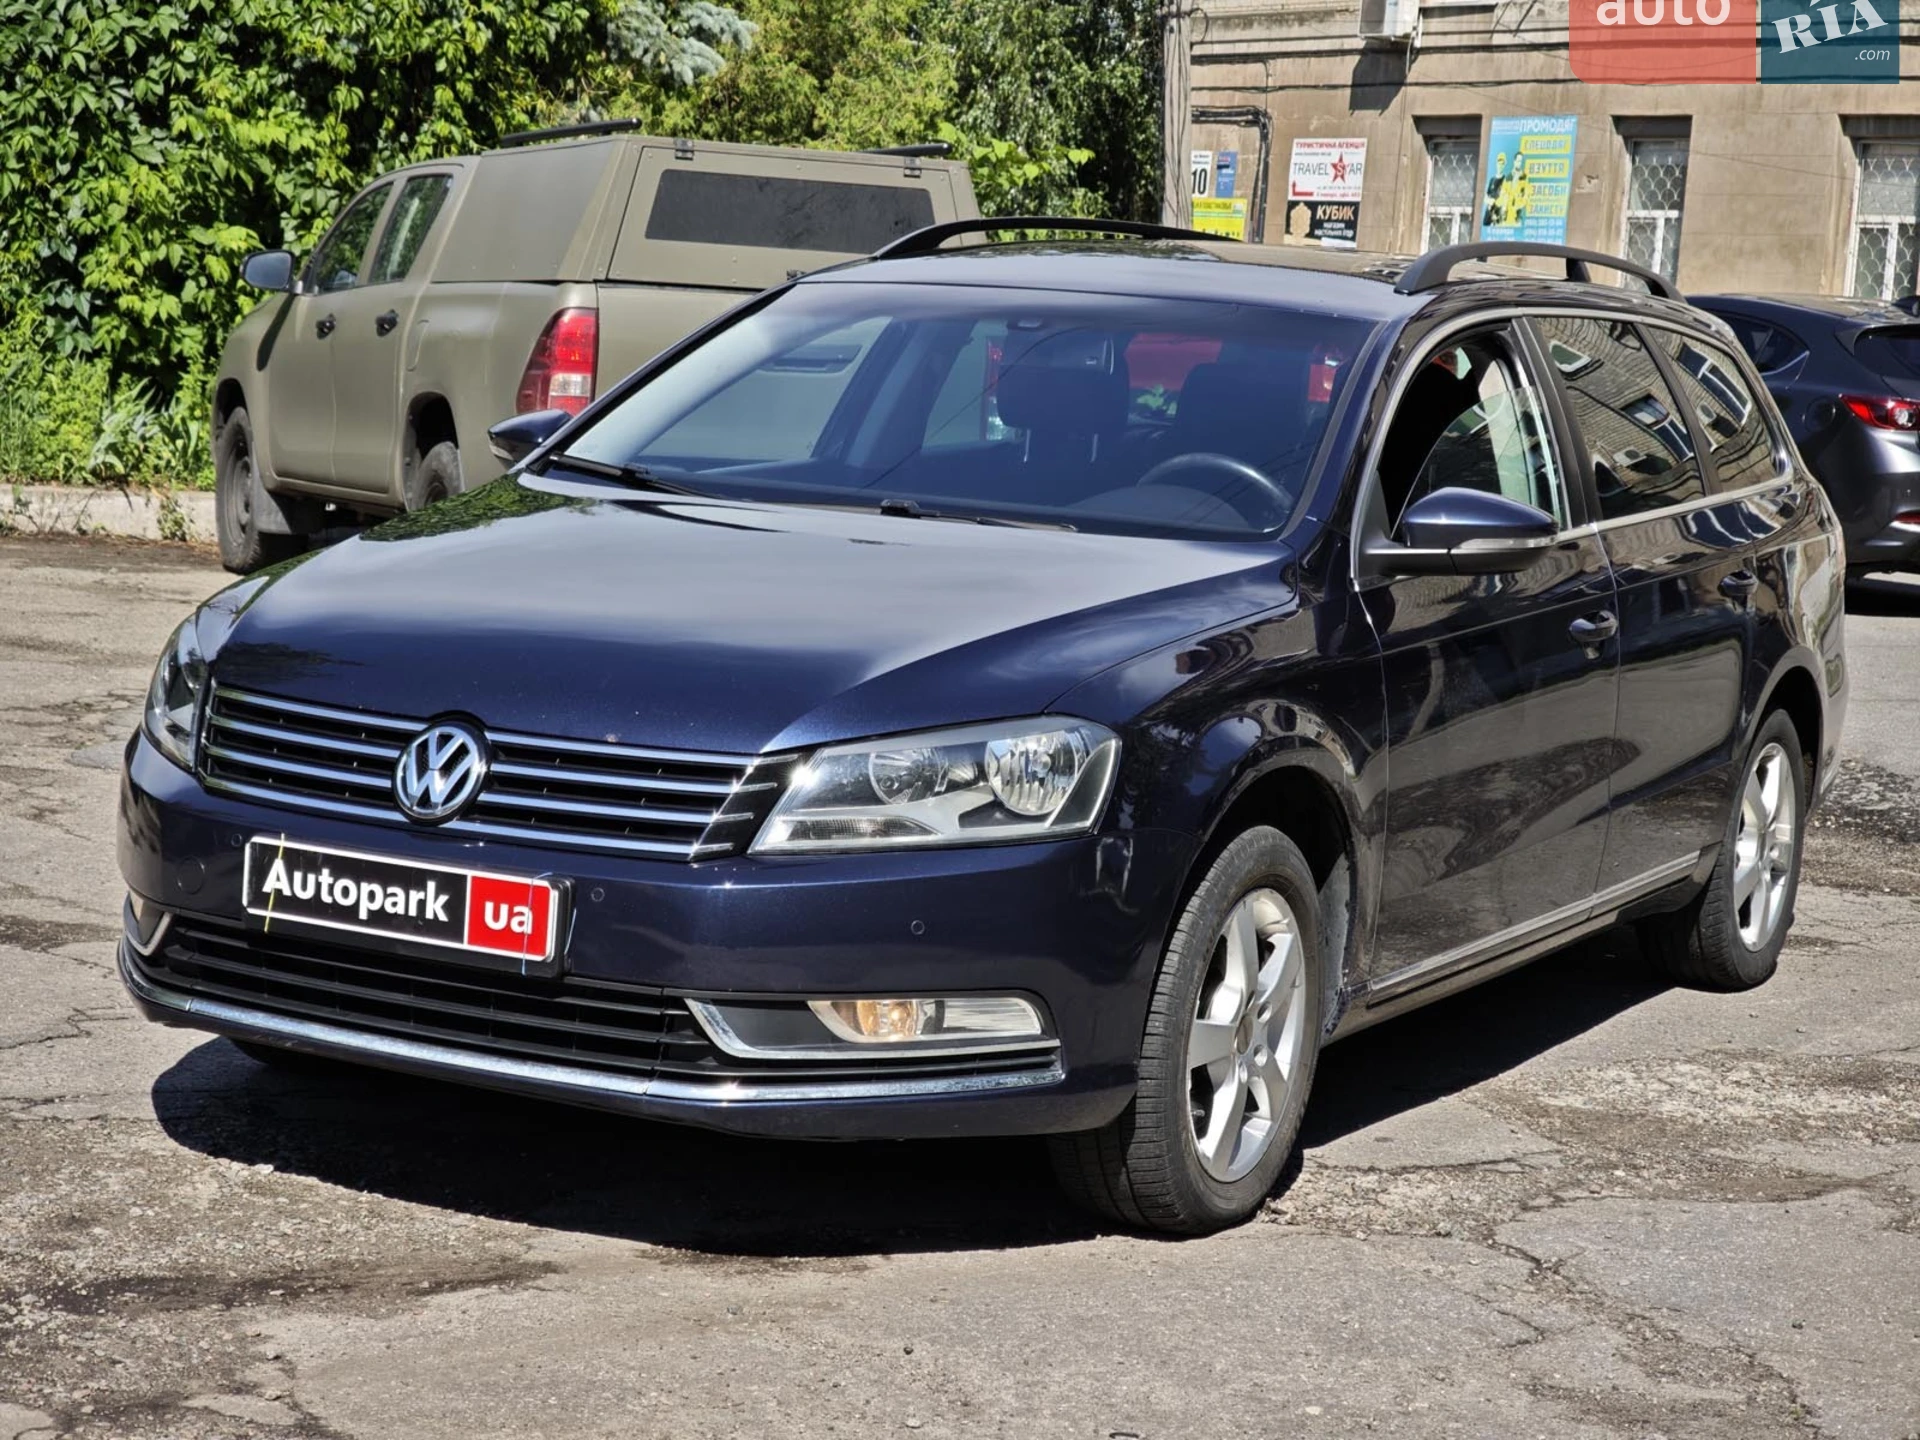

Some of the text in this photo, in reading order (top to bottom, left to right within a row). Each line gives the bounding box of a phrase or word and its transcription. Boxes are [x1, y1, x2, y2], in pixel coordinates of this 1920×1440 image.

[1519, 118, 1576, 133] ПРОМОДЯГ
[1295, 141, 1337, 149] ТУРИСТИЧНА
[1293, 162, 1330, 176] TRAVEL
[1529, 162, 1564, 174] ВЗУТТЯ
[1191, 168, 1208, 195] 10
[1531, 184, 1567, 195] ЗАСОБИ
[1316, 204, 1355, 221] КУБИК
[262, 858, 533, 935] Autopark ua
